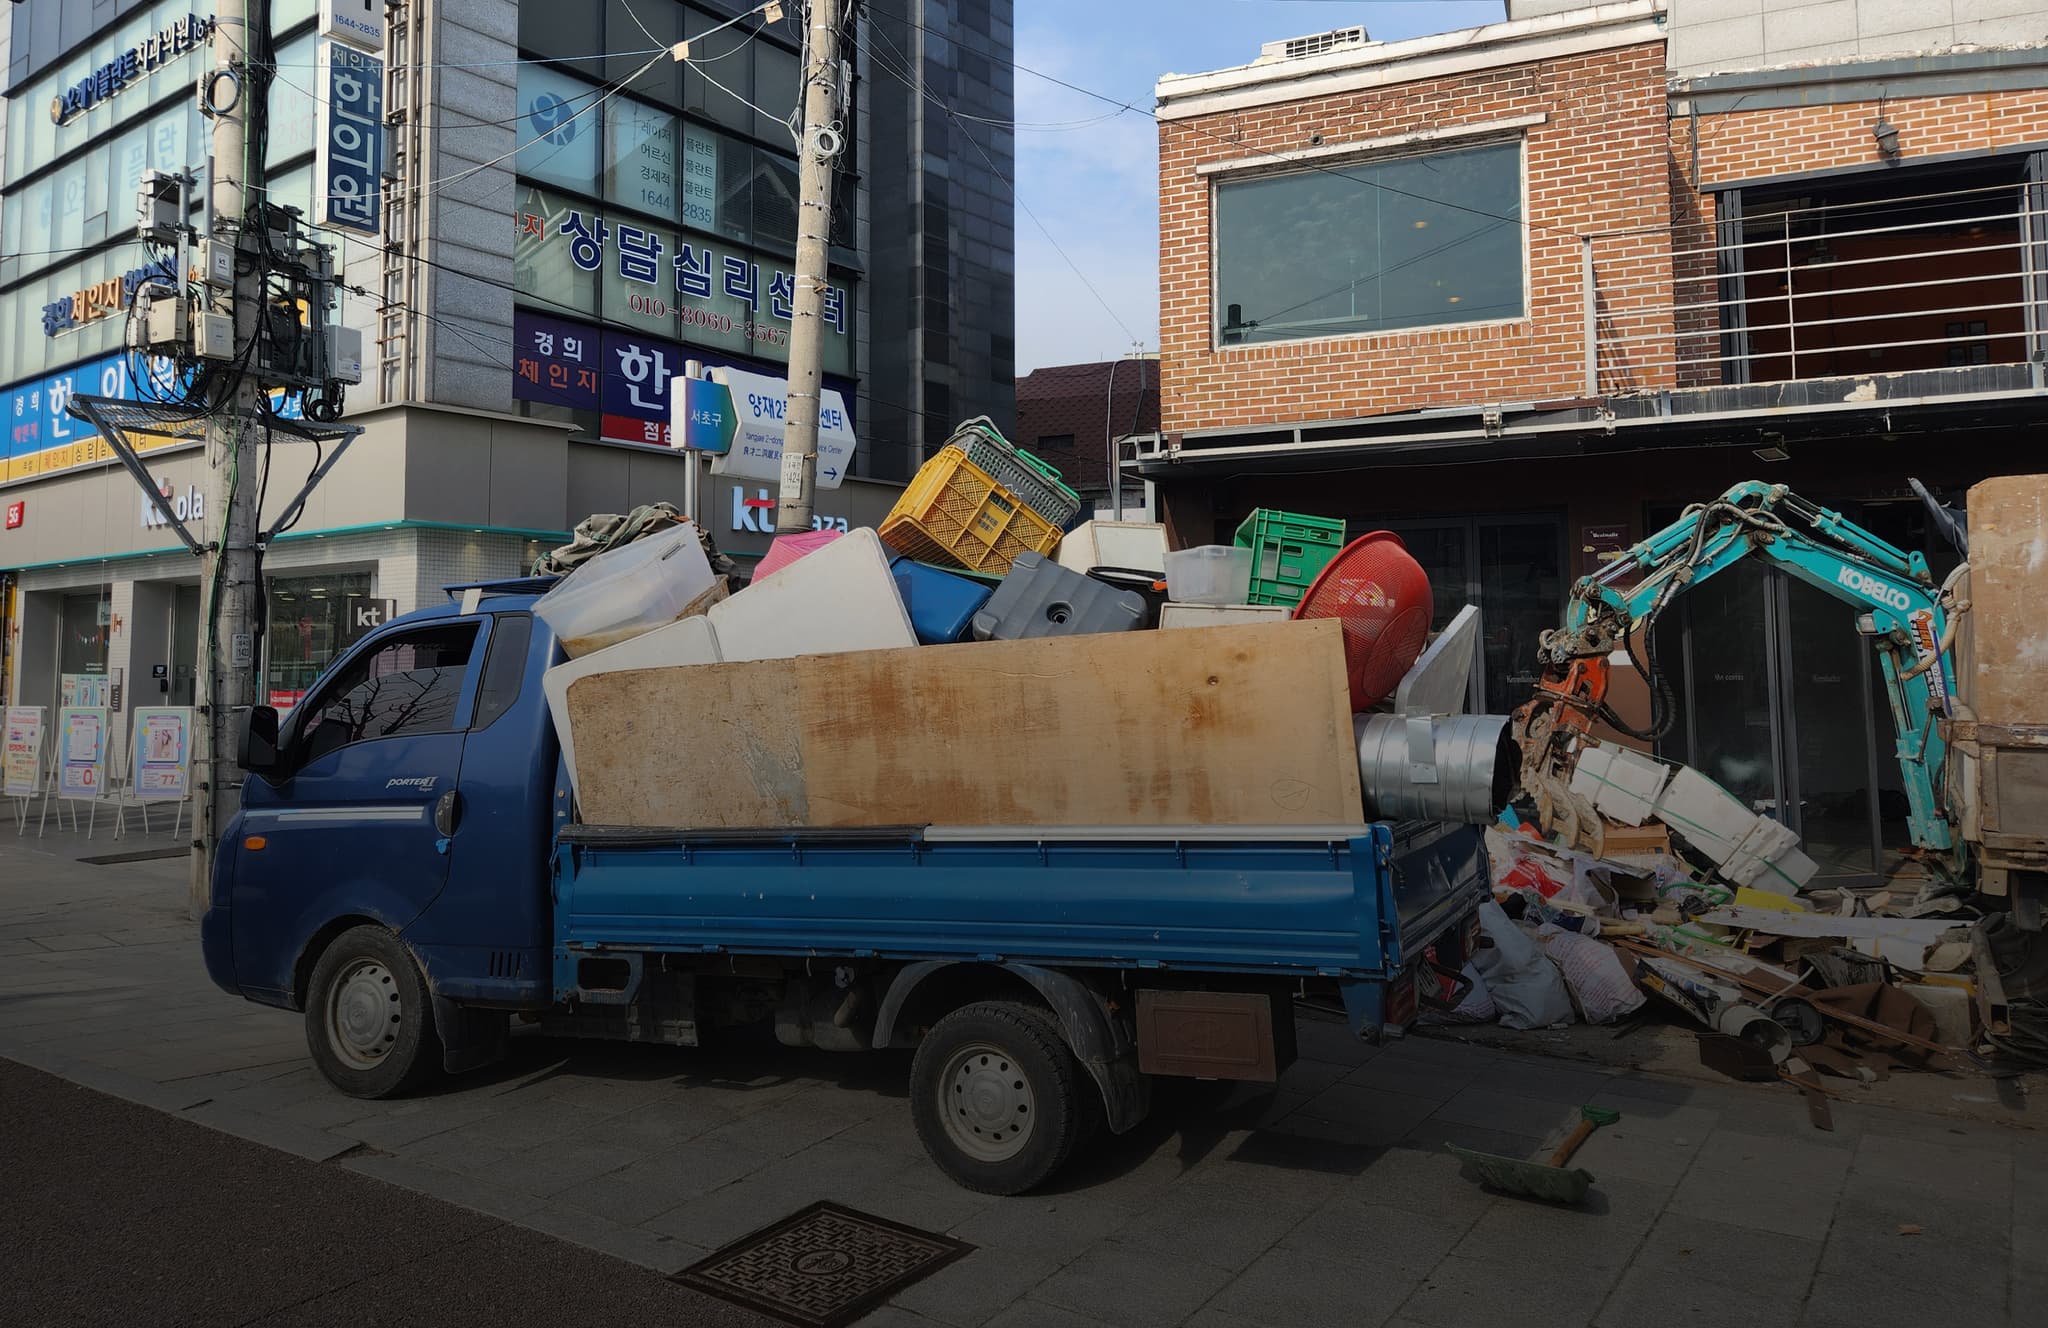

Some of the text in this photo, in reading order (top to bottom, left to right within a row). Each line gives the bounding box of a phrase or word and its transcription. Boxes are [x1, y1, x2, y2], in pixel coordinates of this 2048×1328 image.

[334, 14, 381, 38] 1644-2835
[330, 72, 381, 226] 한의원
[641, 144, 671, 165] 어르신
[641, 166, 670, 187] 경제적
[641, 189, 712, 224] 1644 2835
[630, 293, 789, 347] 010-8060-3567
[534, 330, 583, 363] 경희
[518, 357, 597, 394] 체인지
[690, 409, 723, 428] 서초구
[748, 393, 788, 420] 양재2
[731, 485, 776, 533] kt
[1837, 564, 1911, 611] KOBELCO
[357, 606, 382, 627] kt
